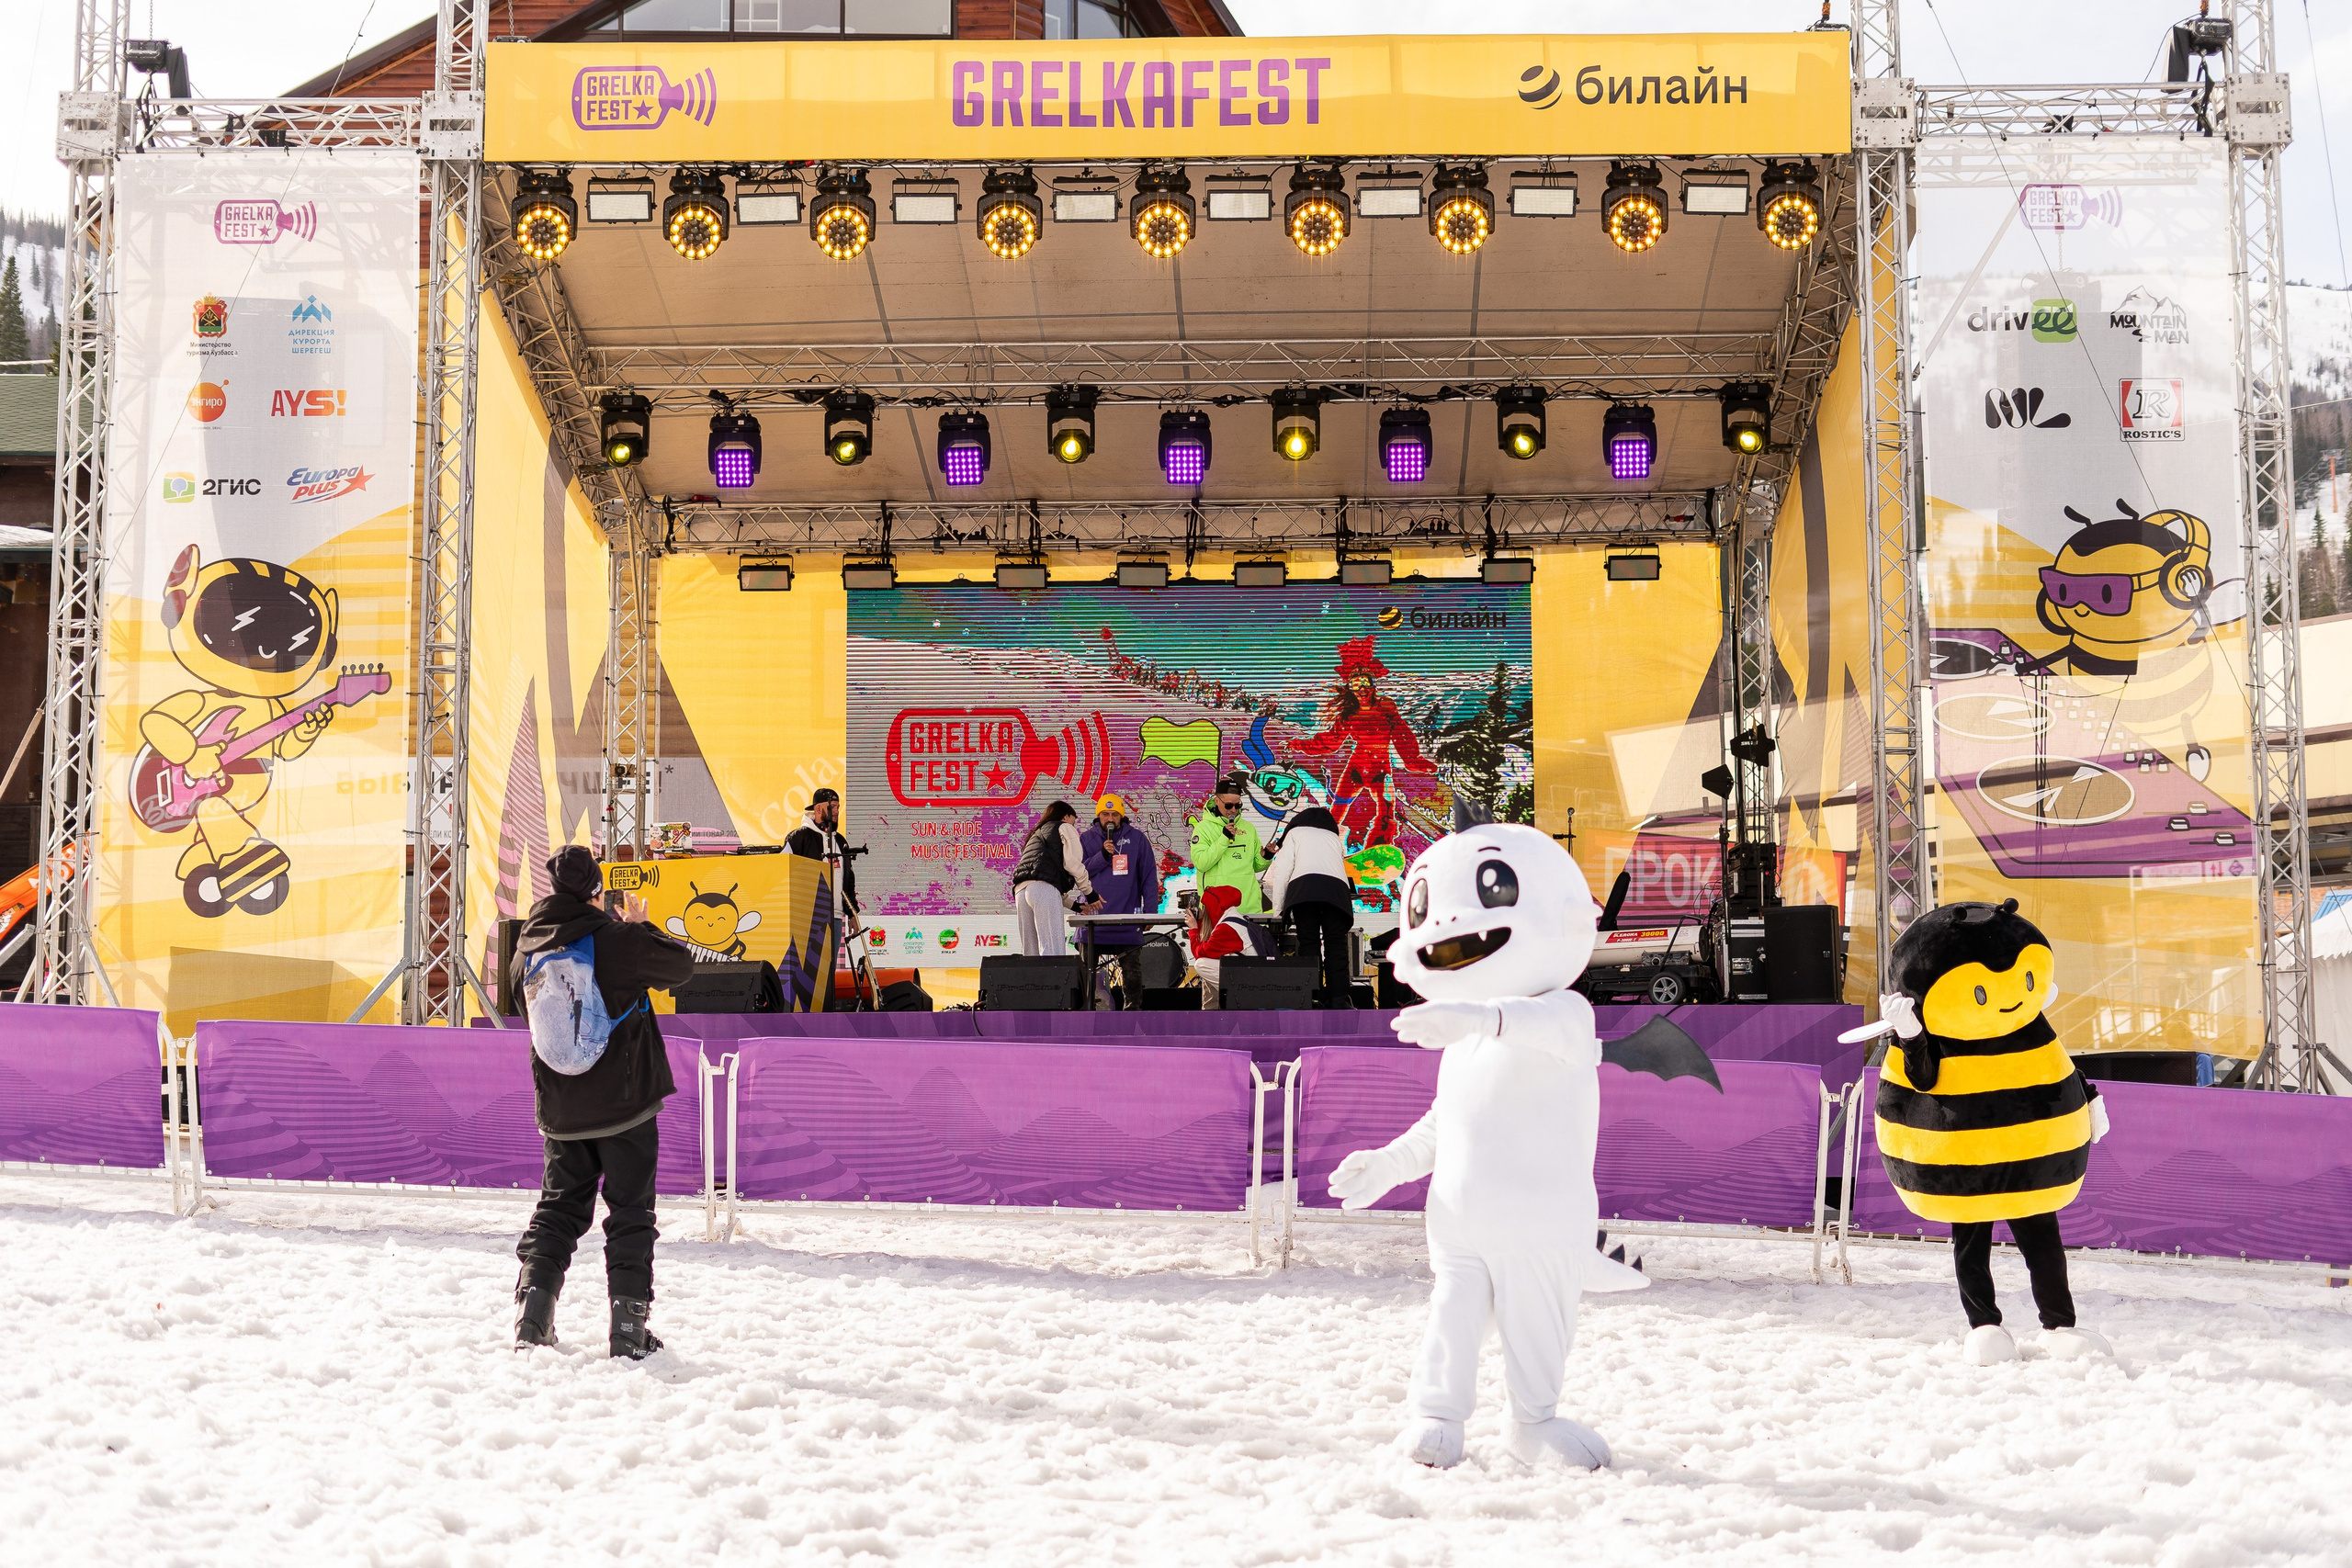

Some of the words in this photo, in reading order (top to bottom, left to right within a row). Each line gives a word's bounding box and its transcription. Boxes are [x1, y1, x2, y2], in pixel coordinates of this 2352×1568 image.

[587, 74, 655, 96] GRELKA
[952, 57, 1331, 128] GRELKAFEST
[1576, 64, 1747, 105] билайн
[586, 99, 633, 121] FEST
[2030, 190, 2078, 206] GRELKA
[224, 206, 274, 221] GRELKA
[2030, 207, 2063, 223] FEST
[224, 222, 256, 238] FEST
[2109, 314, 2187, 330] MOUNTAIN
[288, 329, 335, 337] ДИРЕКЦИЯ
[2154, 330, 2189, 344] MAN
[270, 389, 347, 417] AYS!
[2122, 429, 2182, 439] ROSTIC'S
[202, 478, 262, 496] 2ГИС
[1409, 605, 1508, 629] билайн
[910, 722, 1013, 754] GRELKA
[910, 760, 979, 792] FEST
[911, 821, 937, 837] SUN
[940, 821, 949, 837] &
[952, 821, 983, 837] RIDE
[911, 844, 951, 859] MUSIC
[954, 844, 1013, 859] FESTIVAL
[614, 869, 639, 878] GRELKA
[614, 878, 631, 887] FEST
[632, 1348, 652, 1358] HEA
